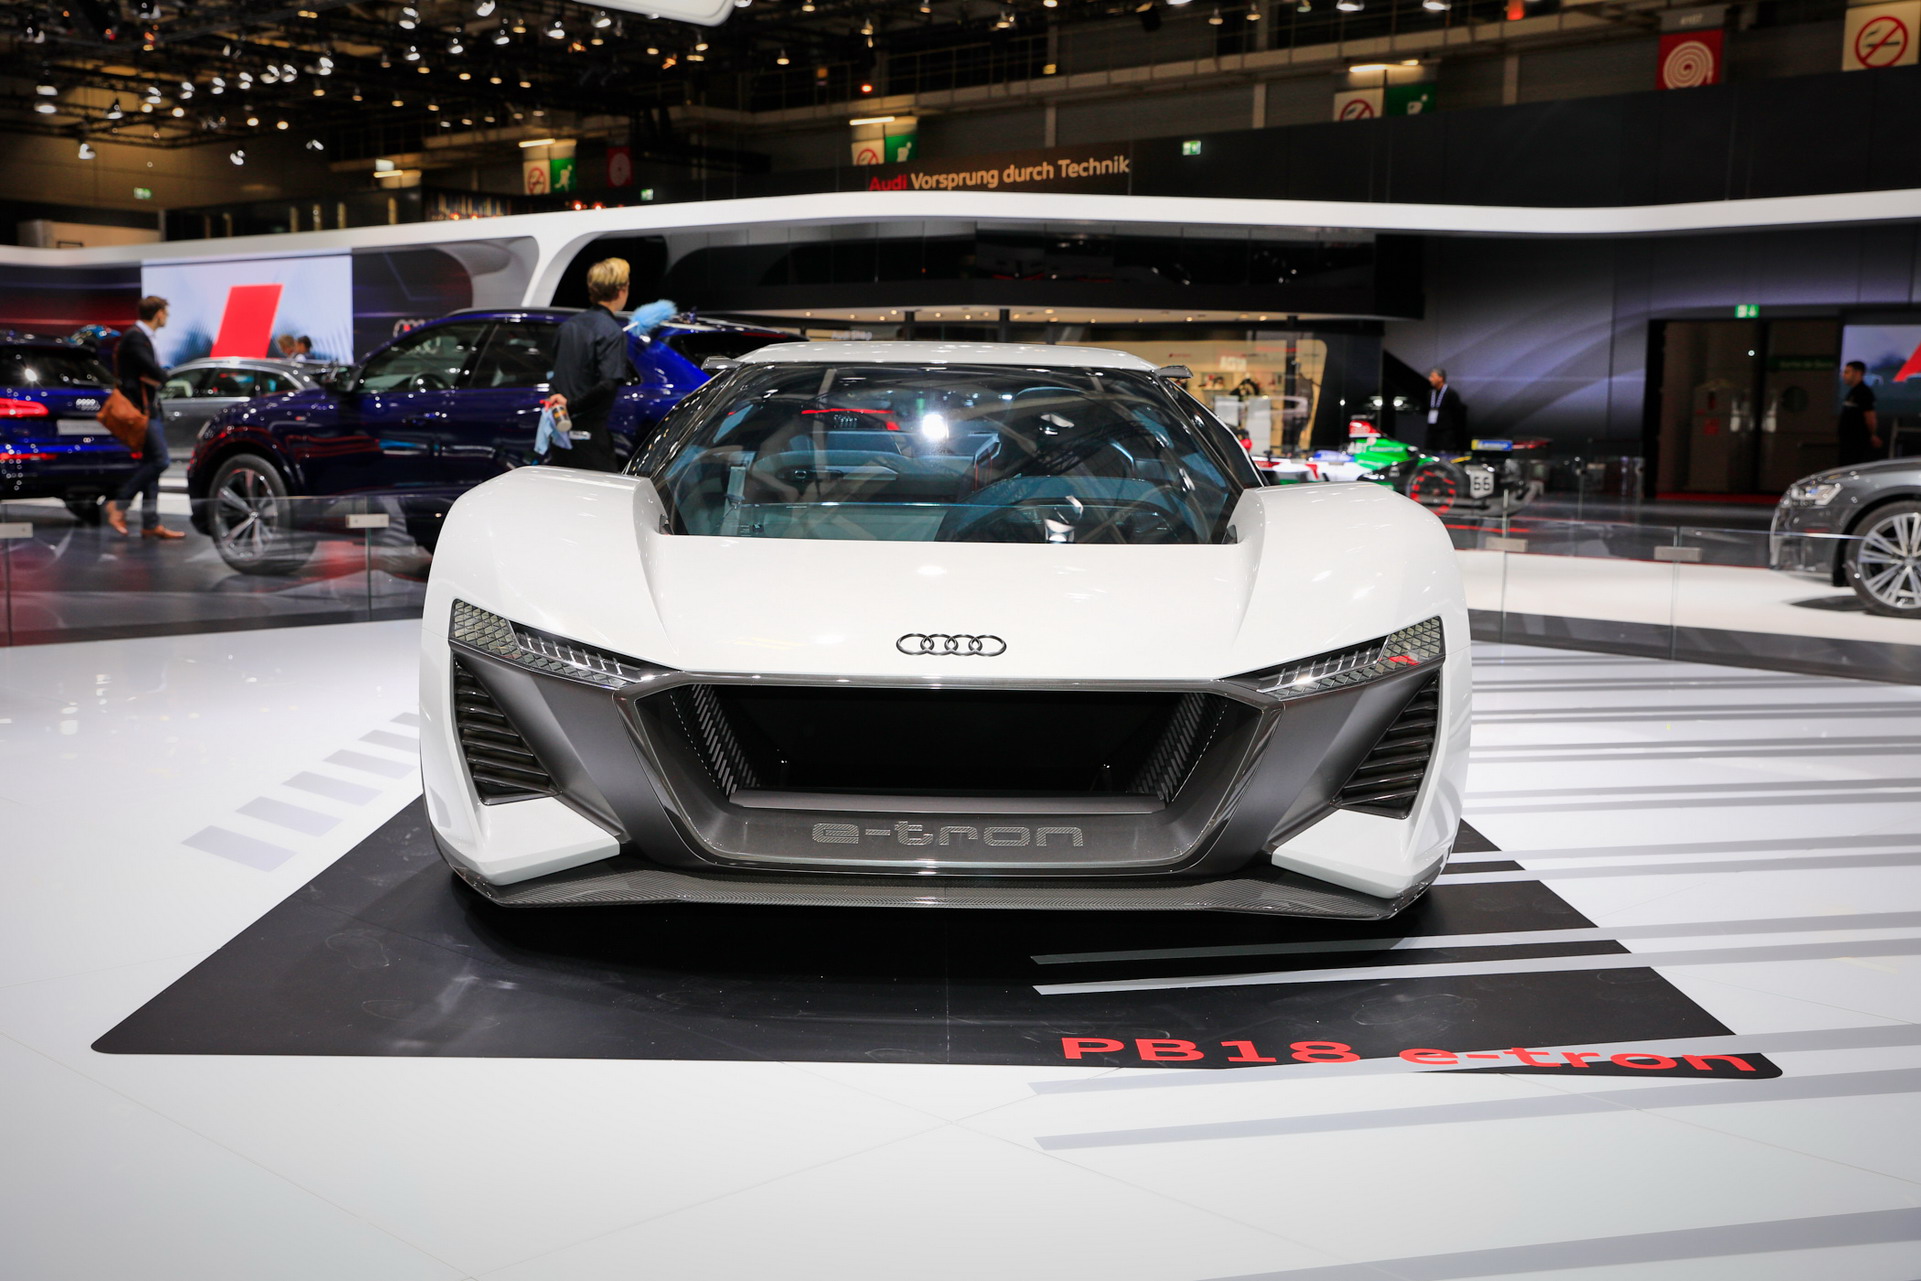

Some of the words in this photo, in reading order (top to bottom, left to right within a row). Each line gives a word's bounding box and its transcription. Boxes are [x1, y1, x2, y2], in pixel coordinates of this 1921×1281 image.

[868, 175, 908, 191] Audi
[910, 168, 999, 191] Vorsprung
[1002, 162, 1055, 184] durch
[1057, 155, 1130, 179] Technik
[811, 820, 1084, 847] e-tron
[1060, 1037, 1361, 1064] PB18
[1398, 1046, 1757, 1072] e-tron
